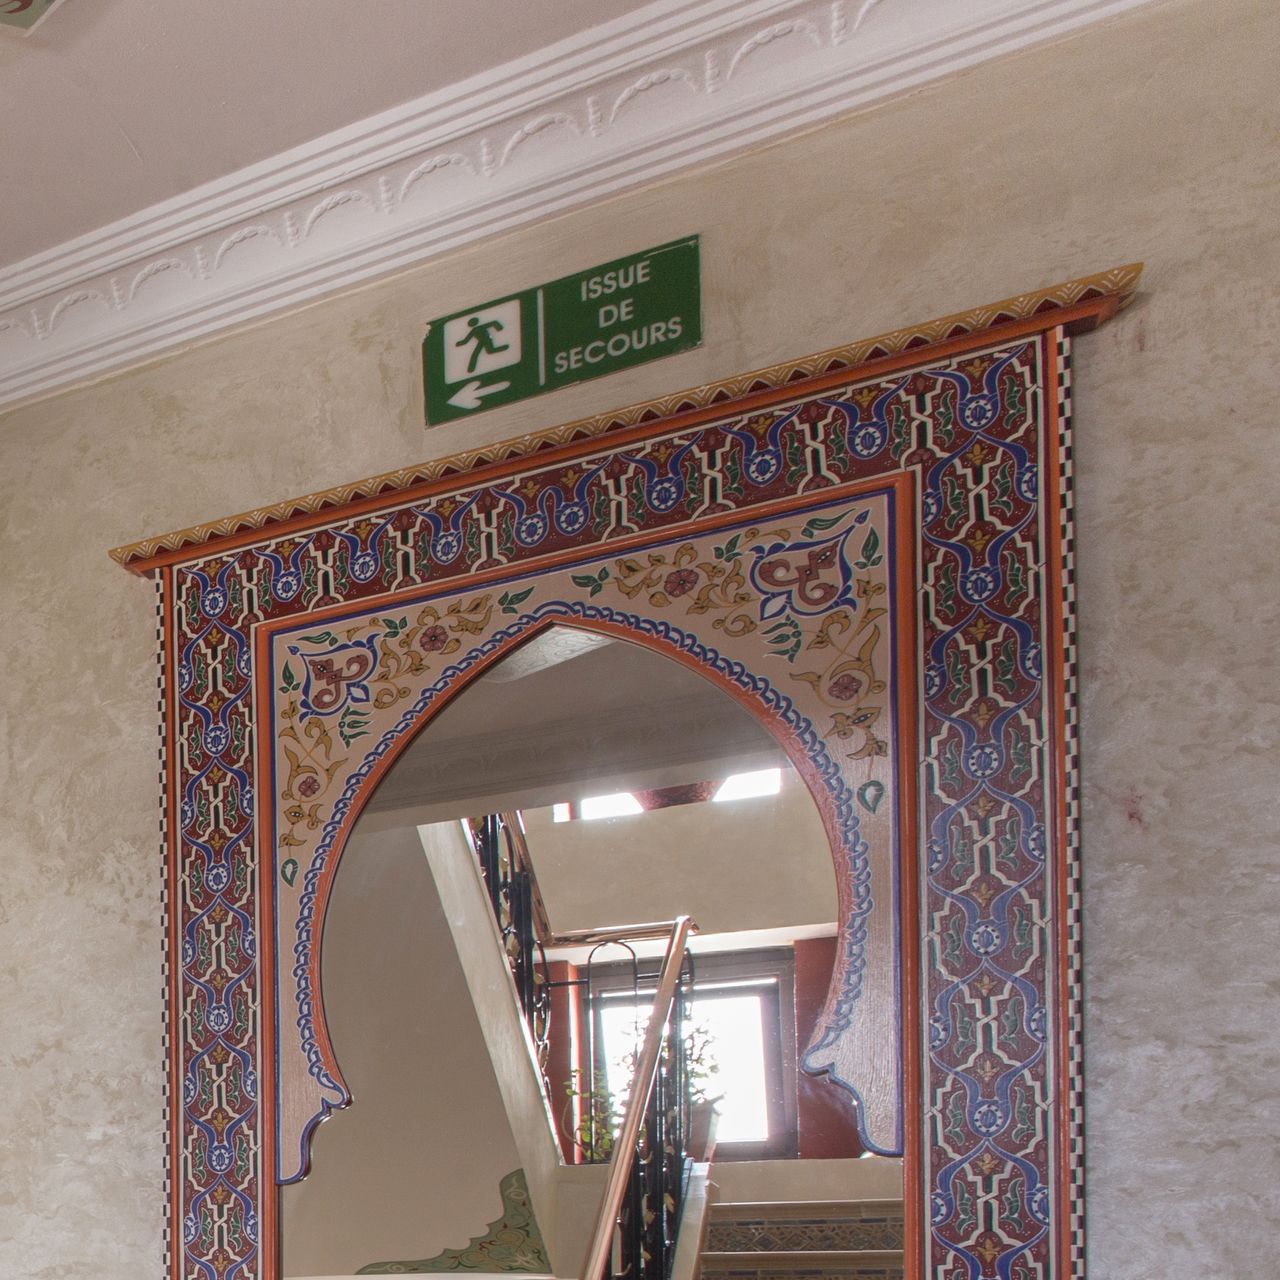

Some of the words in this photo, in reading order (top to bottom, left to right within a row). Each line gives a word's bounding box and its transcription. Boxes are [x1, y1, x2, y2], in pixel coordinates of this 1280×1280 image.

[581, 260, 651, 301] ISSUE
[598, 298, 634, 328] DE
[553, 316, 683, 374] SECOURS
